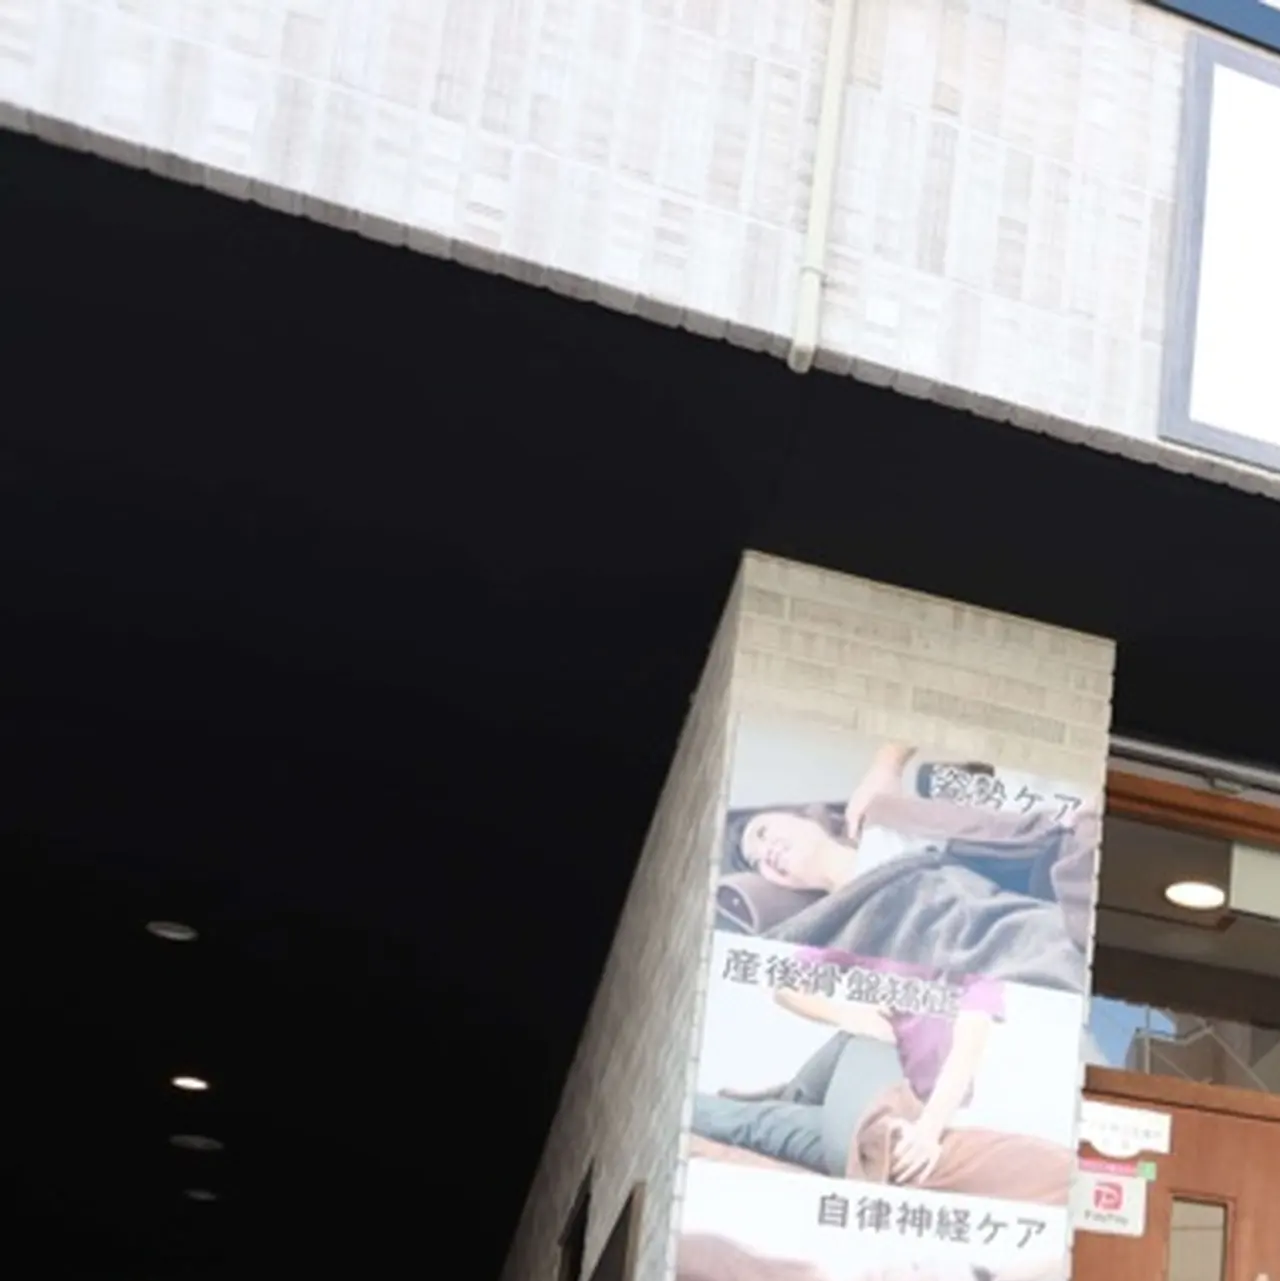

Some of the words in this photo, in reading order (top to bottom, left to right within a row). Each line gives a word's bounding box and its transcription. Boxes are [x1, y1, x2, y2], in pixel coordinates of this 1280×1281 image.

[933, 763, 1083, 821] 姿勢ケア
[817, 1192, 1048, 1248] 自律神経ケア
